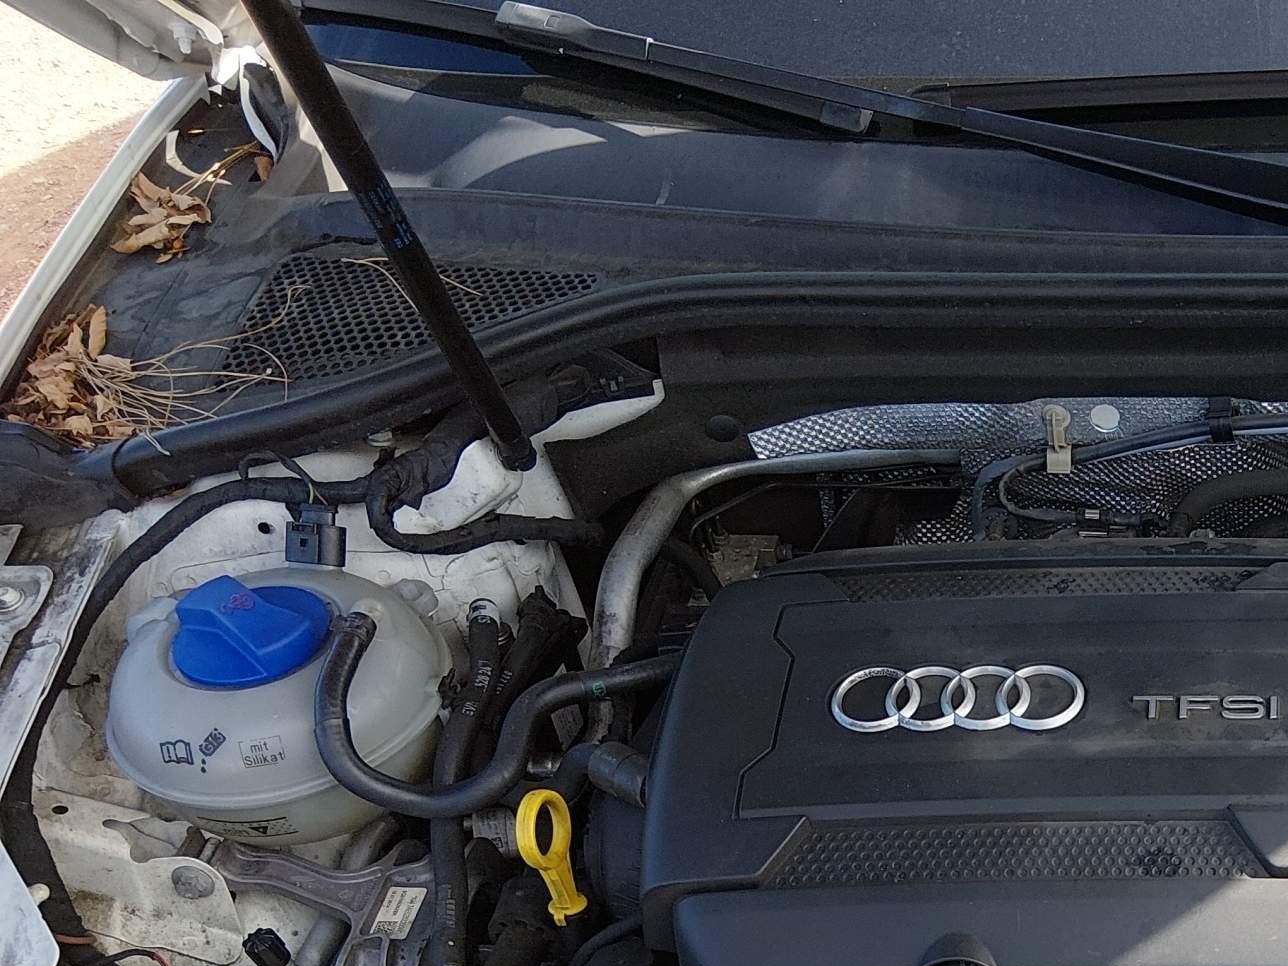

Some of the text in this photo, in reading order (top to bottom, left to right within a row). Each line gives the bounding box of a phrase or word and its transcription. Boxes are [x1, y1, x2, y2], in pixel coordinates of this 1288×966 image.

[1133, 694, 1279, 720] TFSI
[250, 740, 269, 753] mit
[244, 751, 286, 766] Silikat
